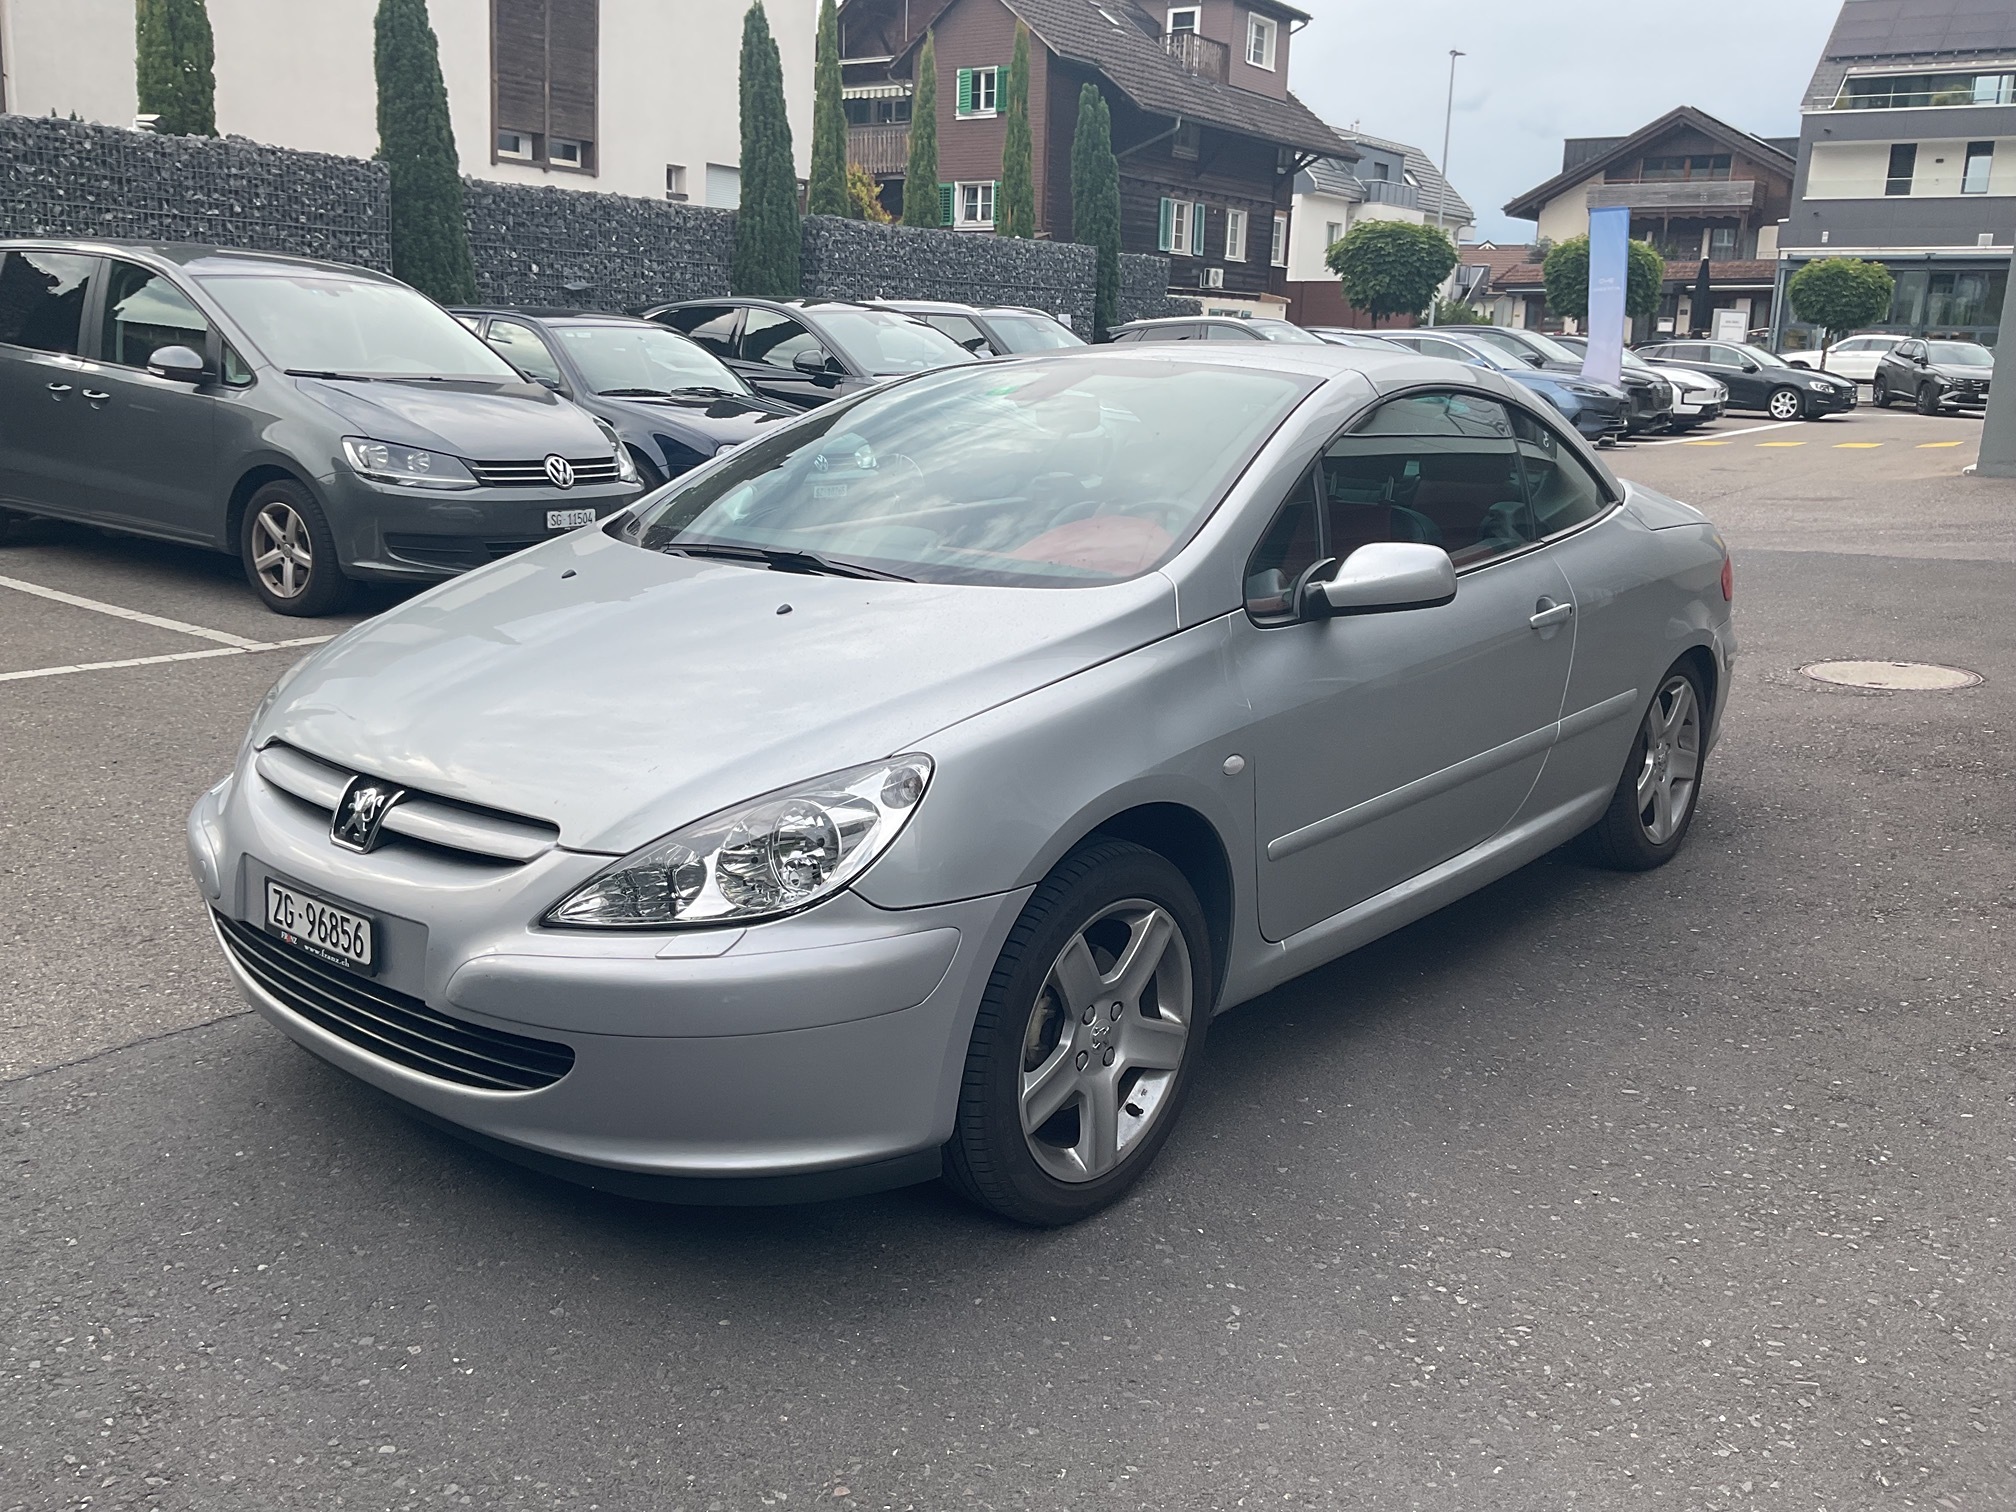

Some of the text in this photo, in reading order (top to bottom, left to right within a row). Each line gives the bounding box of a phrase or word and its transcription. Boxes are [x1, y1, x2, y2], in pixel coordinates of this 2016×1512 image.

[550, 512, 593, 526] SG 11504
[272, 887, 364, 958] ZG 96856
[303, 944, 350, 968] www.franz.ch
